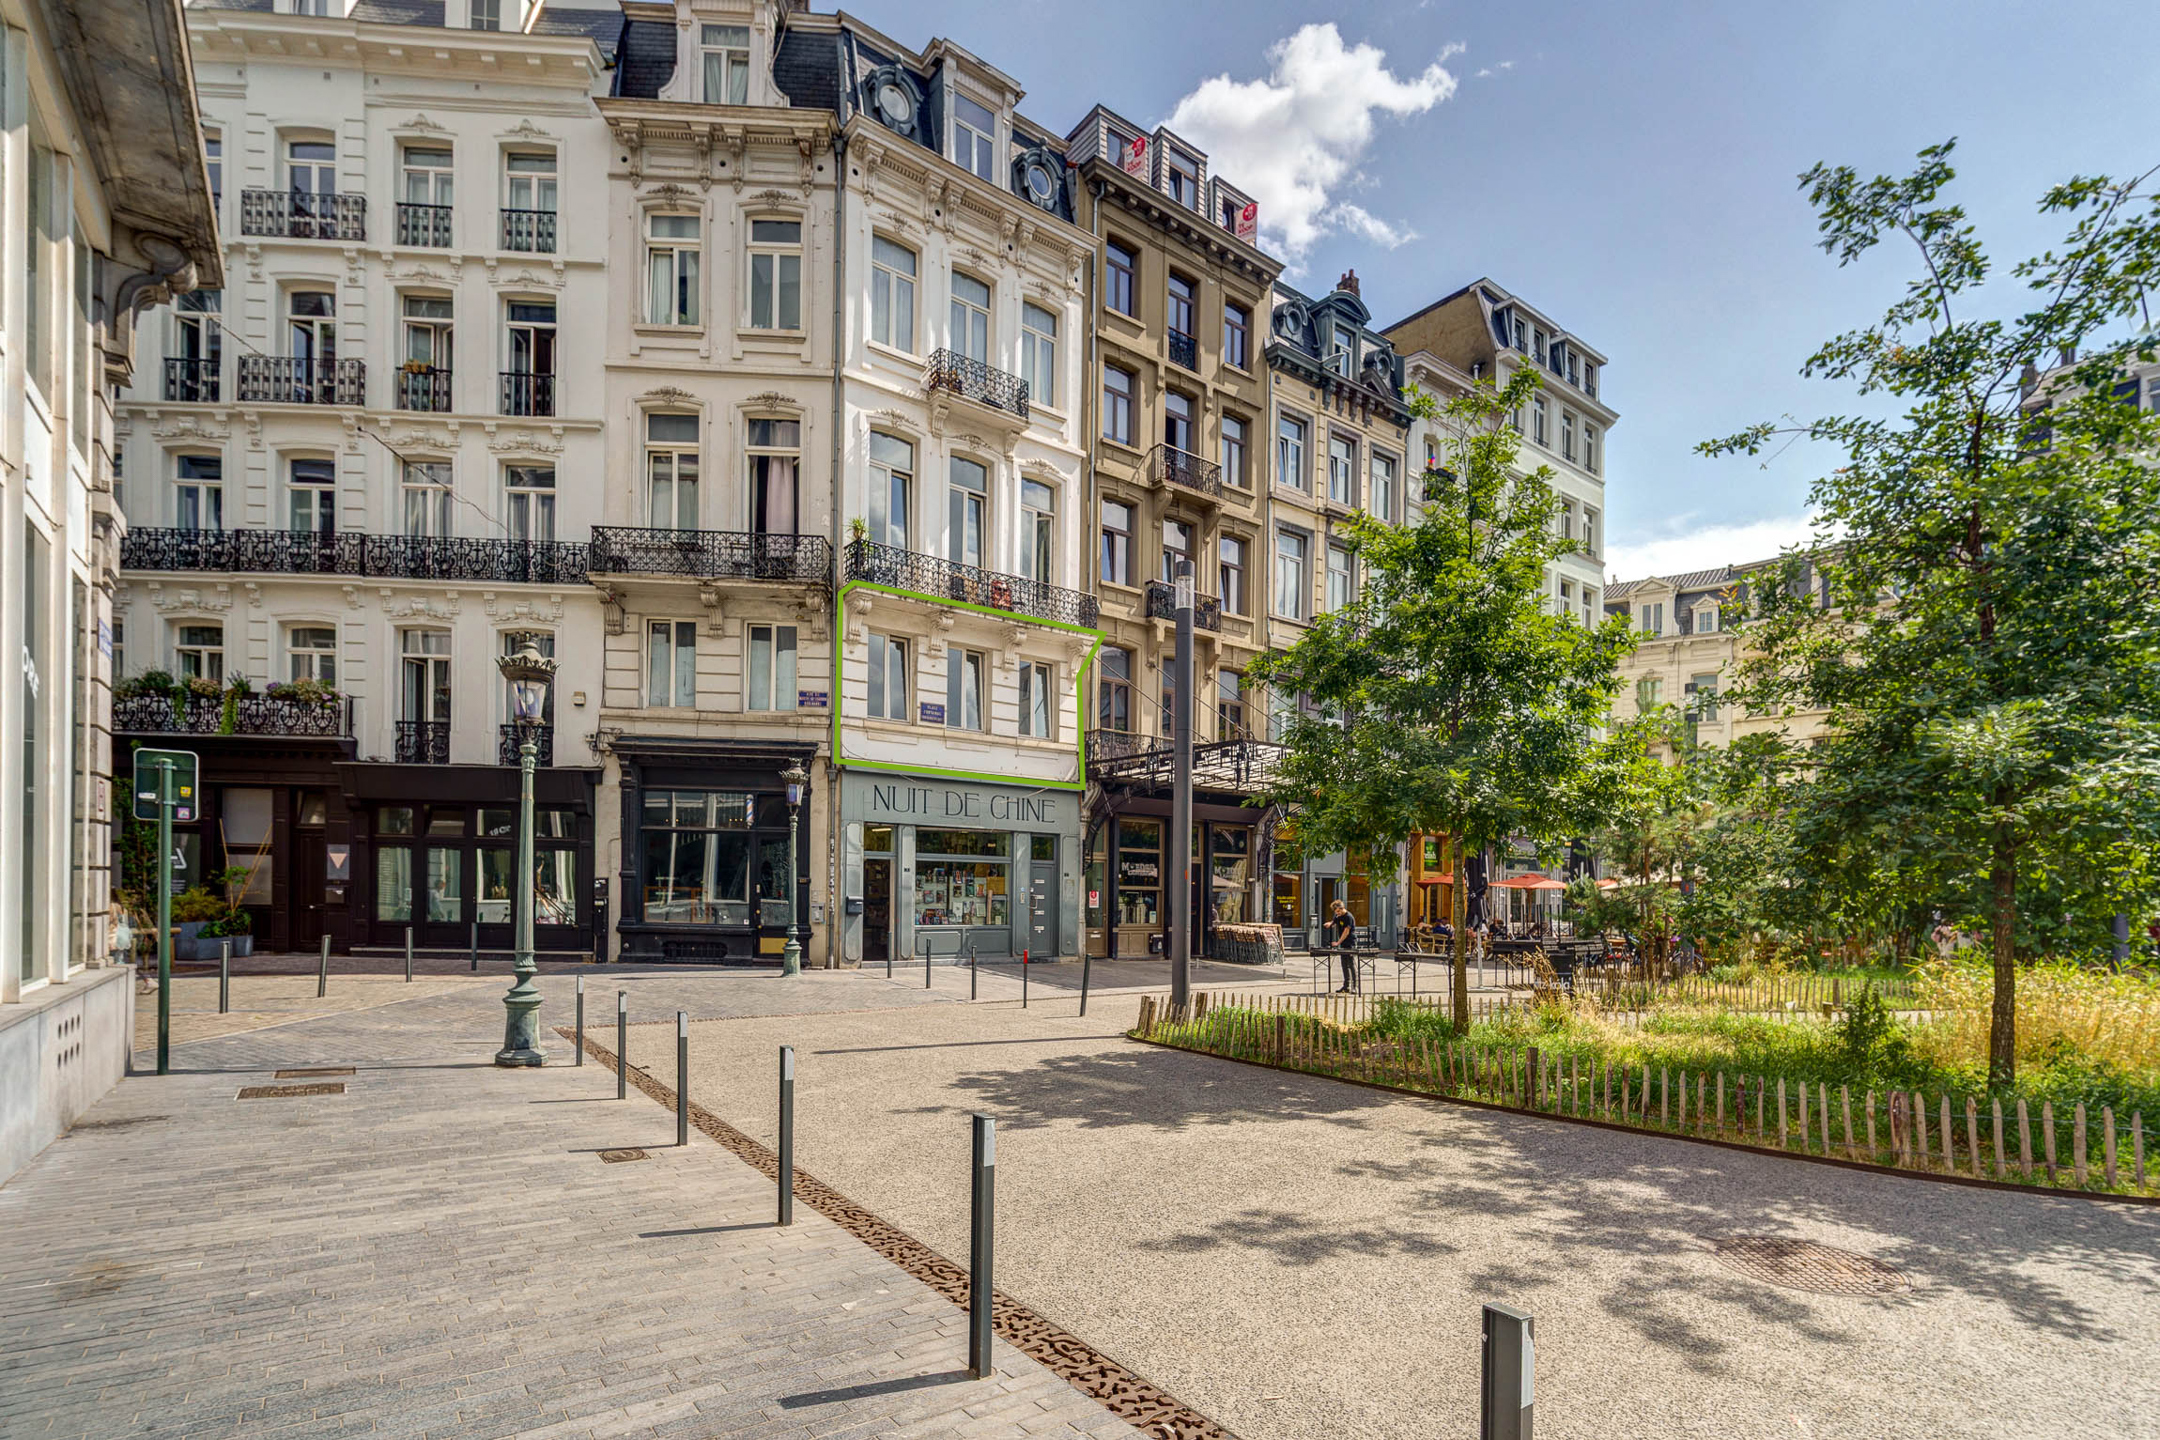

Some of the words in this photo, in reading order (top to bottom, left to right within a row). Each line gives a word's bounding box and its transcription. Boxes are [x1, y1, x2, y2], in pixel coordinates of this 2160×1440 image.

[873, 785, 932, 814] NUIT
[945, 790, 980, 818] DE
[990, 794, 1056, 824] CHINE
